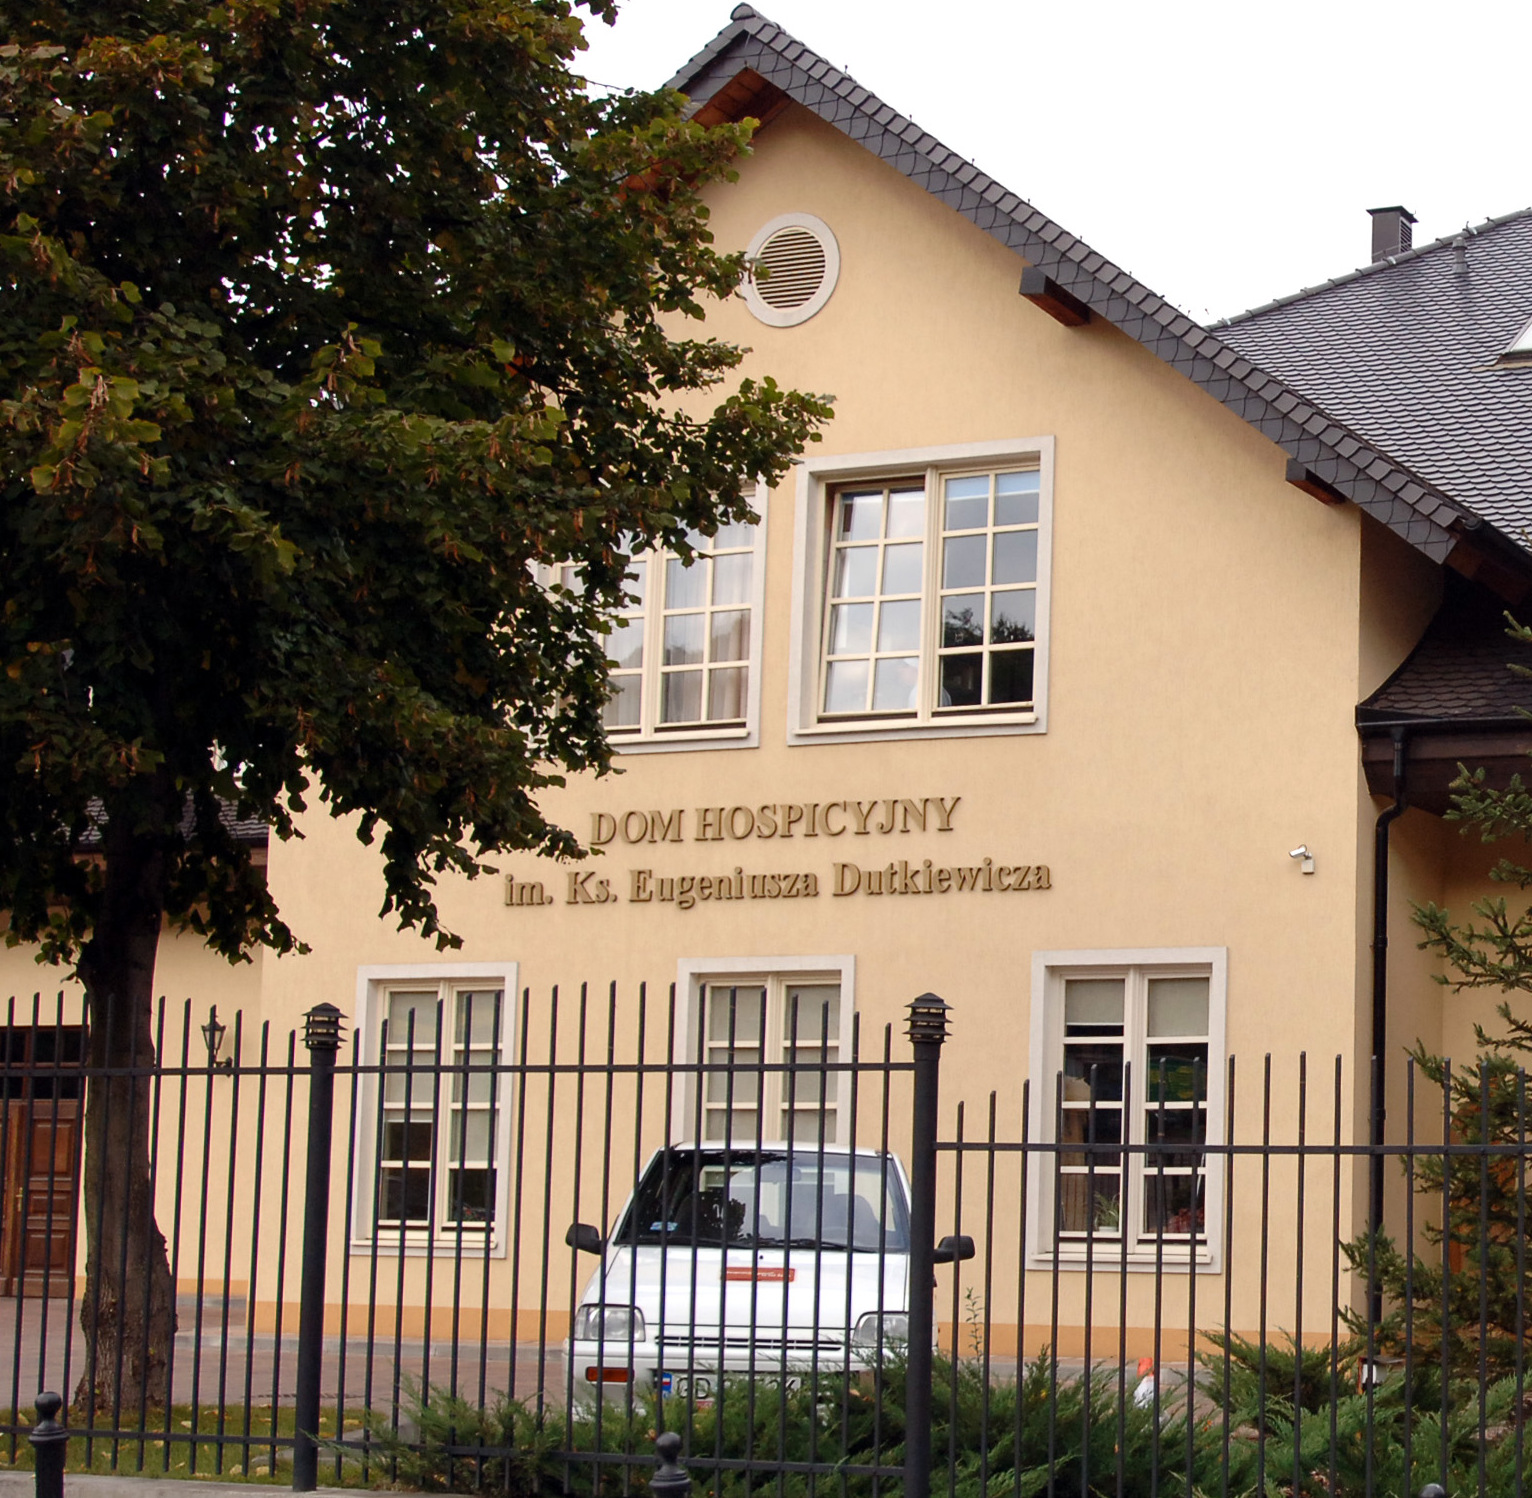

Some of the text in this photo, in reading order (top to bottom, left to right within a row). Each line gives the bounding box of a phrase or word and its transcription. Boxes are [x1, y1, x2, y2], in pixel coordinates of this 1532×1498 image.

[590, 796, 962, 846] DOM HOSPICYJNY
[504, 856, 1053, 910] im. Ks. Eugeniusza Dutkiewicza
